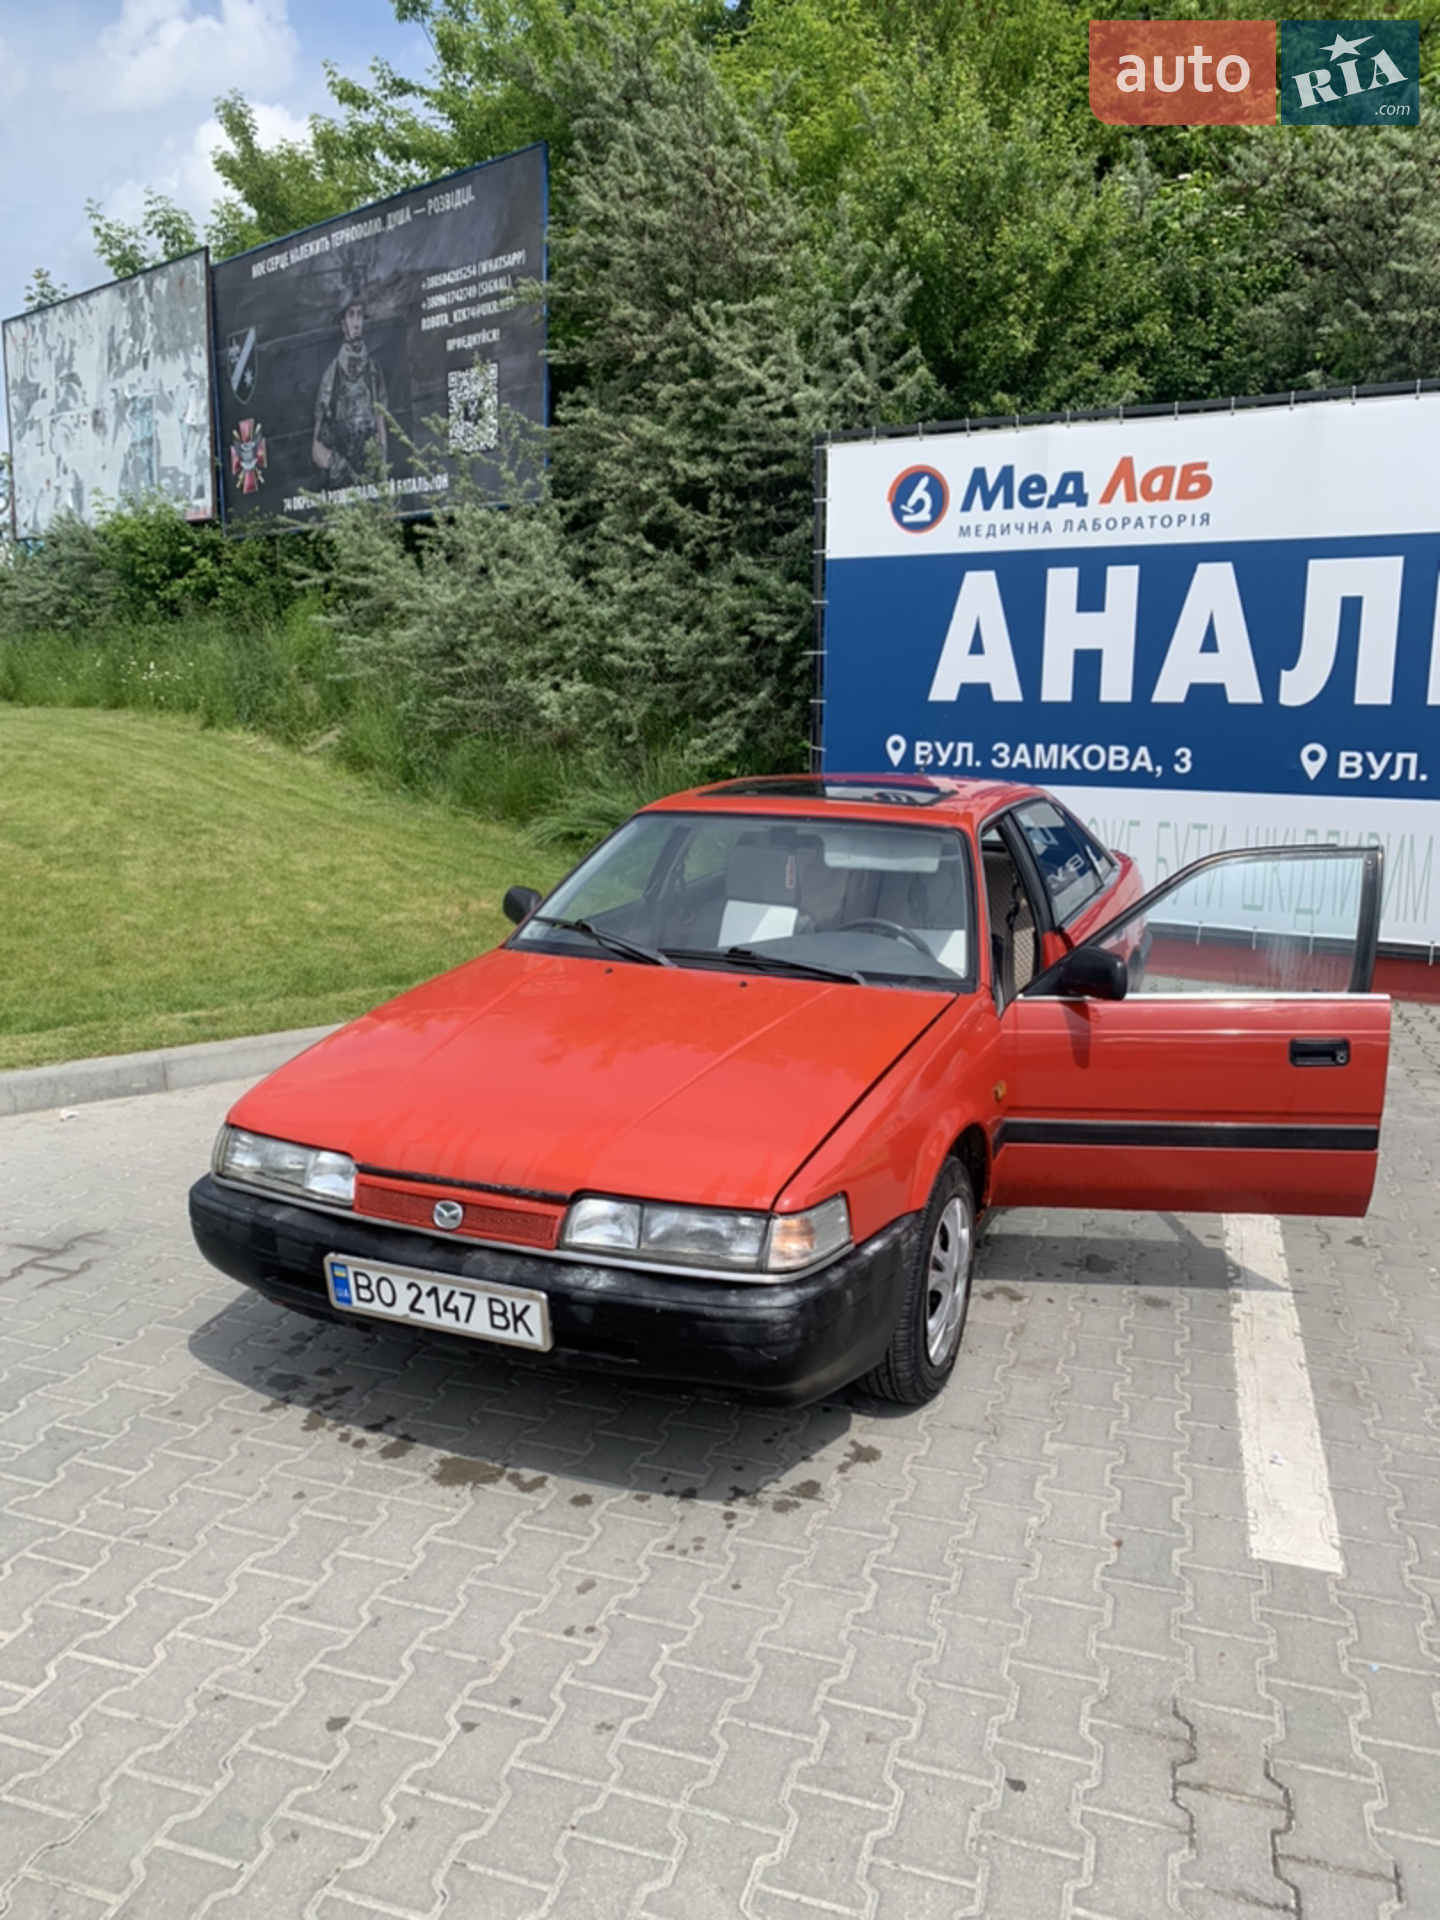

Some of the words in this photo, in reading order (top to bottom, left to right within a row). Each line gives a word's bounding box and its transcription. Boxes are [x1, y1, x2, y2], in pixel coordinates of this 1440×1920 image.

[960, 464, 1089, 512] Мед
[1099, 456, 1213, 505] Лаб
[958, 519, 1053, 539] МЕДИЧНА
[1063, 511, 1211, 534] ЛАБОРАТОРІЯ
[914, 741, 982, 768] ВУЛ.
[991, 742, 1163, 777] ЗАМКОВА,
[1173, 746, 1193, 774] 3
[1337, 751, 1428, 781] ВУЛ.
[353, 1270, 397, 1307] BO
[406, 1282, 476, 1324] 2147
[488, 1297, 534, 1337] BK
